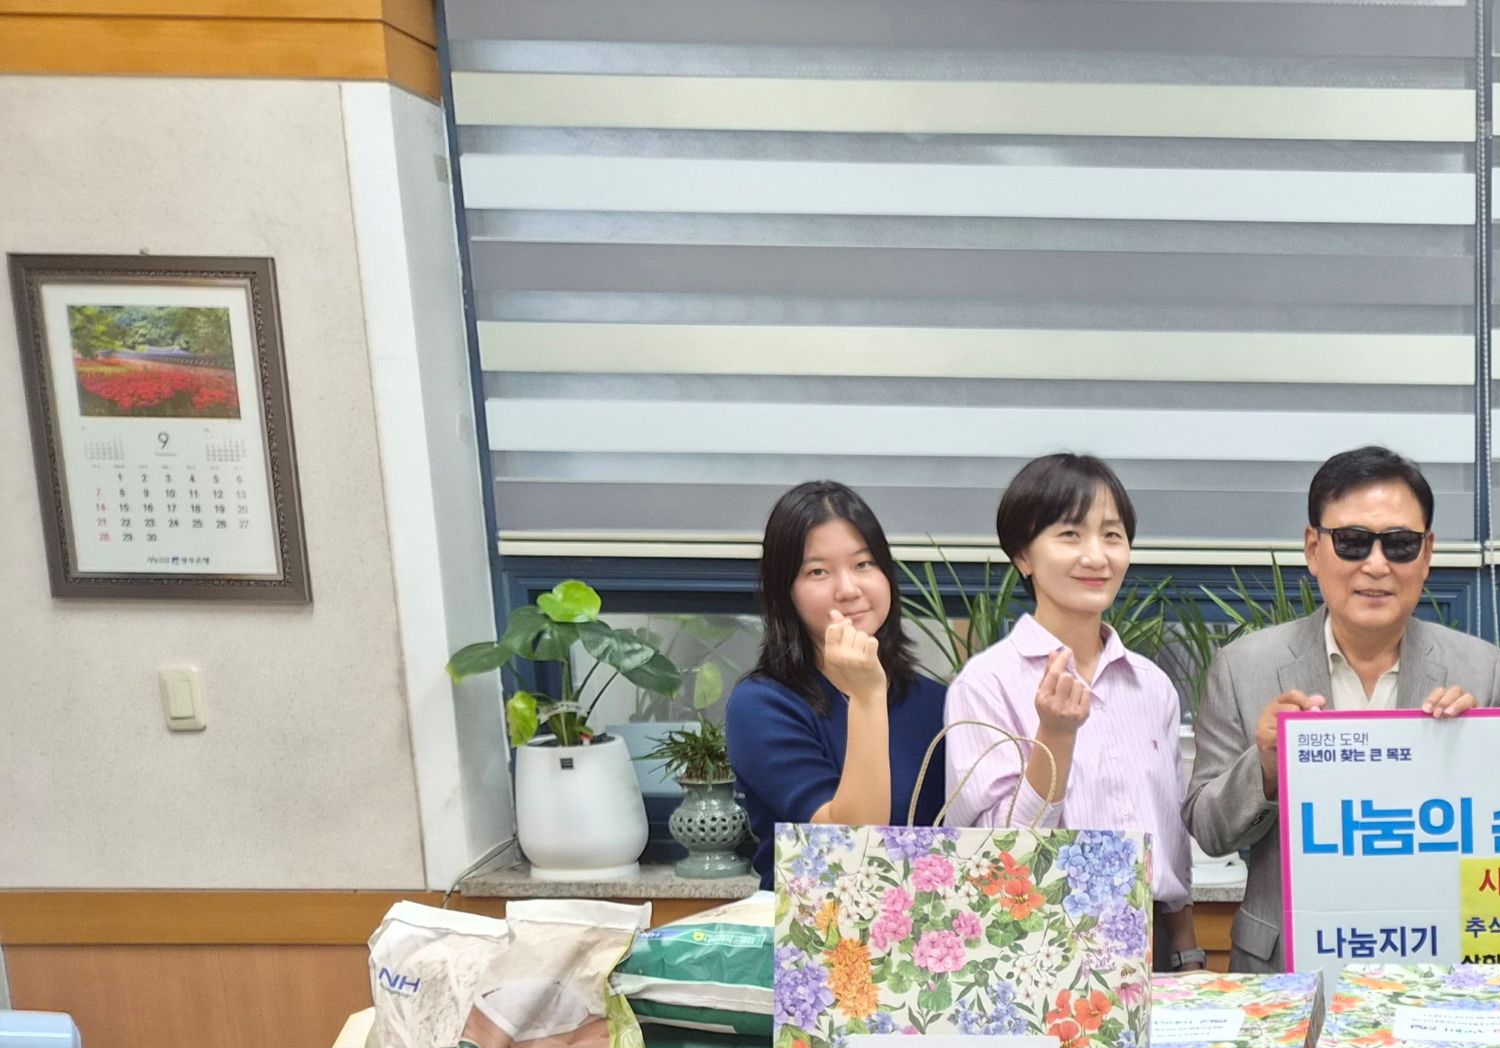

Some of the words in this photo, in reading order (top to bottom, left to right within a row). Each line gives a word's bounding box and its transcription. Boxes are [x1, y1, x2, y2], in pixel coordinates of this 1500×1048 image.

[157, 431, 170, 450] 9
[118, 473, 122, 481] 1
[142, 474, 147, 483] 2
[165, 474, 171, 483] 3
[189, 474, 195, 483] 4
[120, 489, 125, 497] 8
[144, 489, 149, 497] 9
[165, 489, 175, 498] 10
[189, 490, 198, 498] 11
[213, 490, 223, 499] 12
[96, 503, 106, 511] 14
[120, 504, 129, 512] 15
[144, 504, 153, 512] 16
[168, 504, 176, 512] 17
[191, 504, 201, 513] 18
[215, 505, 225, 513] 19
[121, 519, 131, 527] 22
[145, 519, 155, 527] 23
[169, 519, 179, 527] 24
[216, 520, 226, 528] 26
[240, 520, 249, 528] 27
[123, 534, 132, 542] 29
[1298, 733, 1336, 747] 희망찬
[1340, 733, 1369, 746] 도약!
[1298, 749, 1336, 762] 청년이
[1340, 749, 1366, 762] 찾는
[1370, 749, 1382, 761] 큰
[1387, 748, 1412, 761] 목포
[1301, 797, 1474, 856] 나눔의
[1316, 925, 1438, 958] 나눔지기
[379, 967, 420, 992] NH
